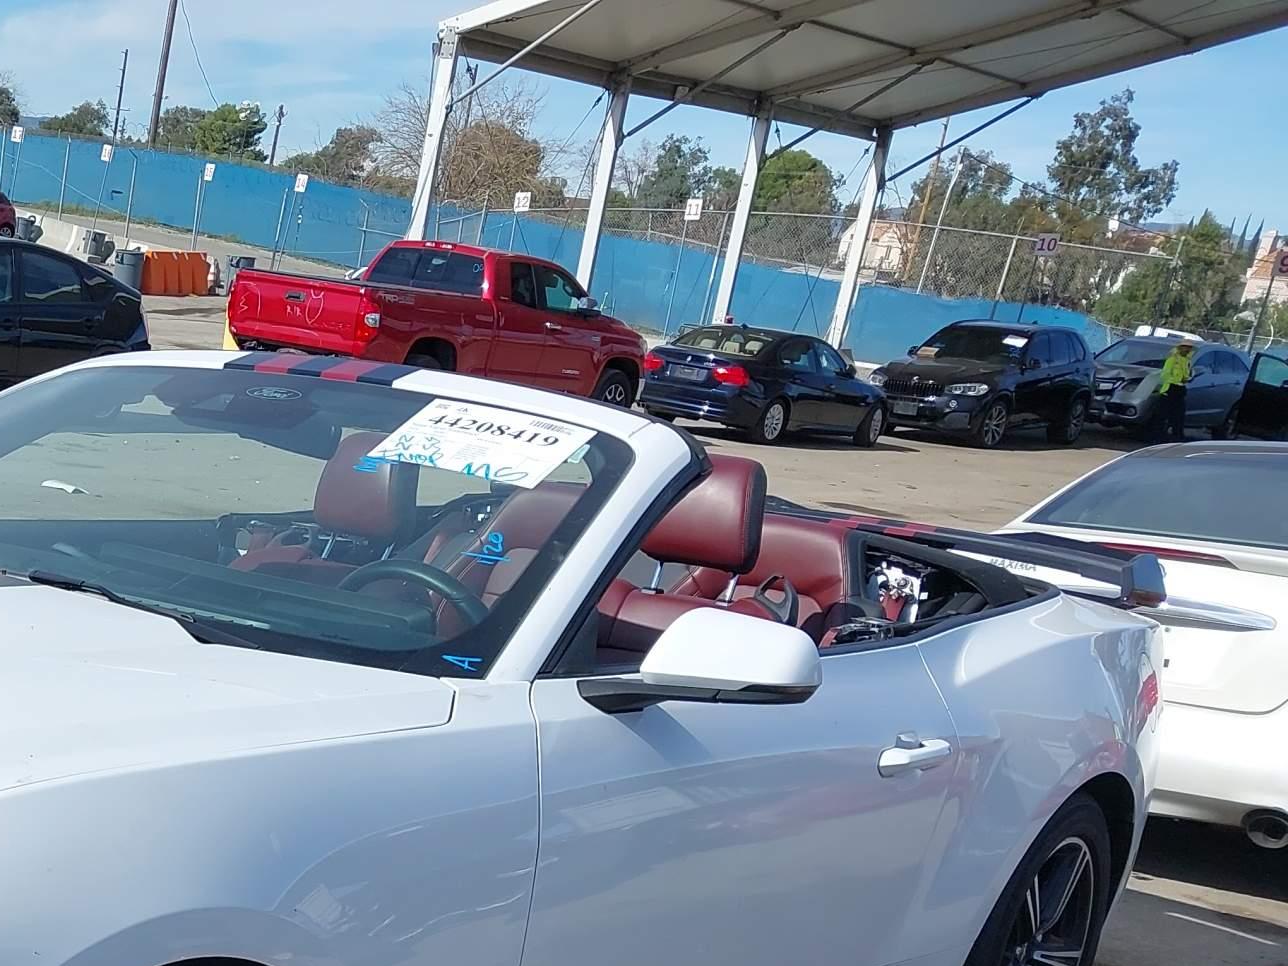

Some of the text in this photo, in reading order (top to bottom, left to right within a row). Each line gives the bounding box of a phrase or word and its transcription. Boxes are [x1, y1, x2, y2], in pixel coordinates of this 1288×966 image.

[515, 196, 529, 208] 12
[687, 203, 700, 216] 11
[1038, 237, 1058, 251] 10
[428, 415, 559, 446] 44208419
[440, 654, 483, 671] A
